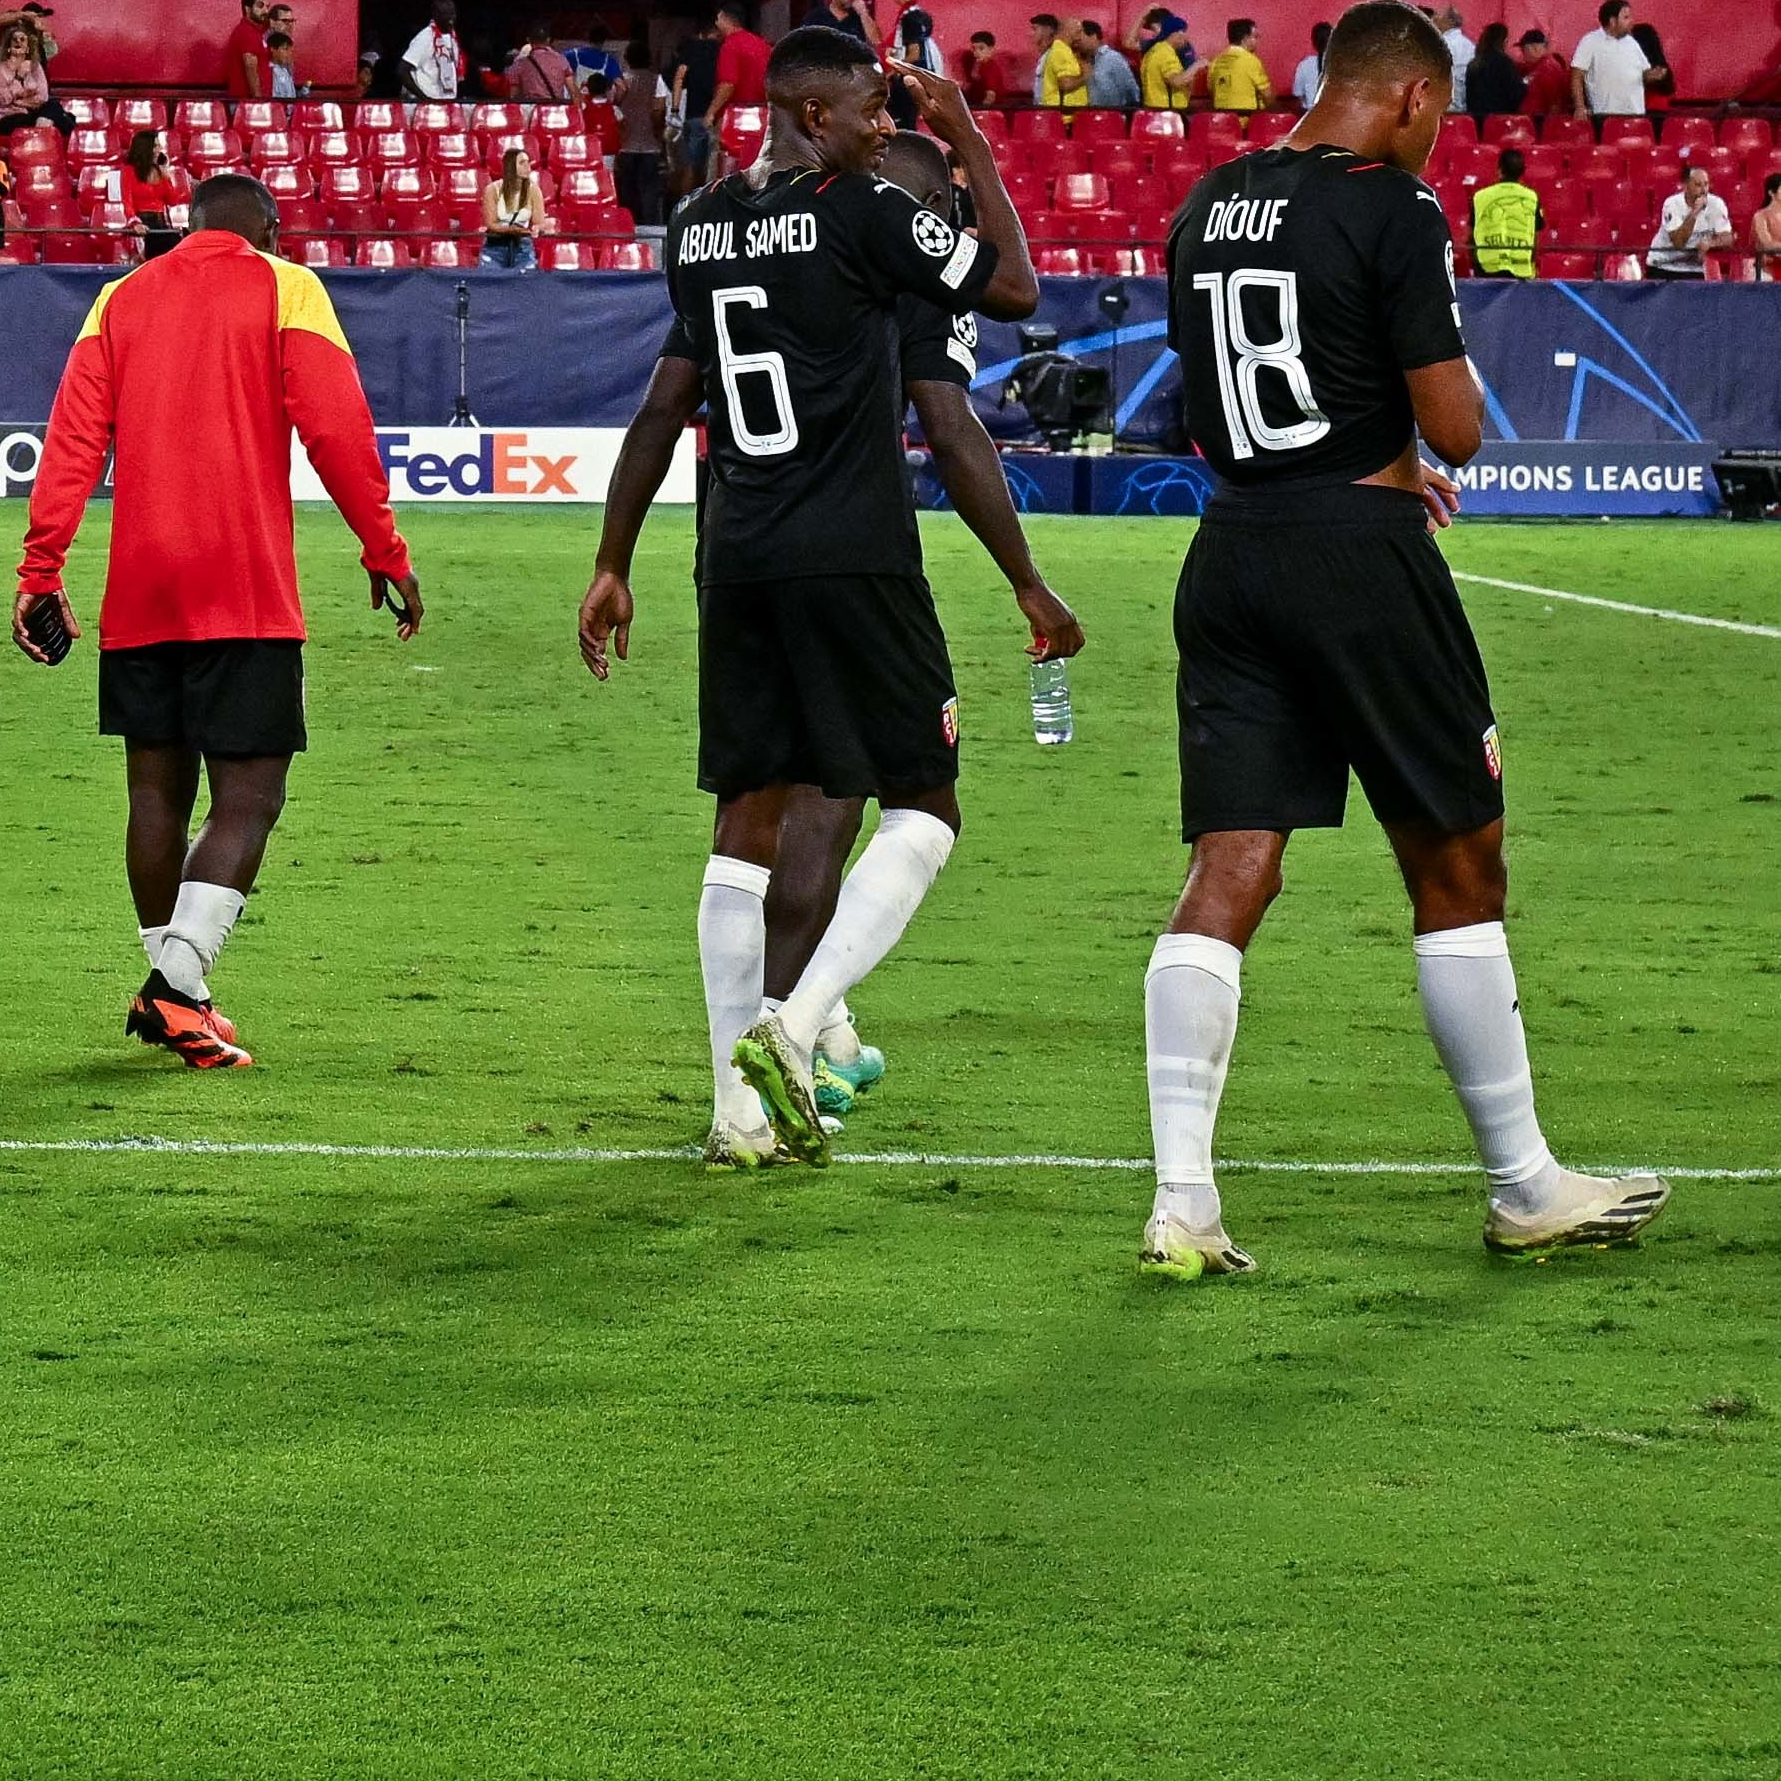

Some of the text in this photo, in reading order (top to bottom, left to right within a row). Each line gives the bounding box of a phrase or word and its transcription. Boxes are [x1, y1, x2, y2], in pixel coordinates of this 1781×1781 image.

[678, 212, 817, 266] ABDUL SAMED
[711, 285, 800, 457] 6
[1192, 268, 1332, 461] 18
[377, 433, 579, 496] FedEx
[1585, 465, 1704, 492] LEAGUE
